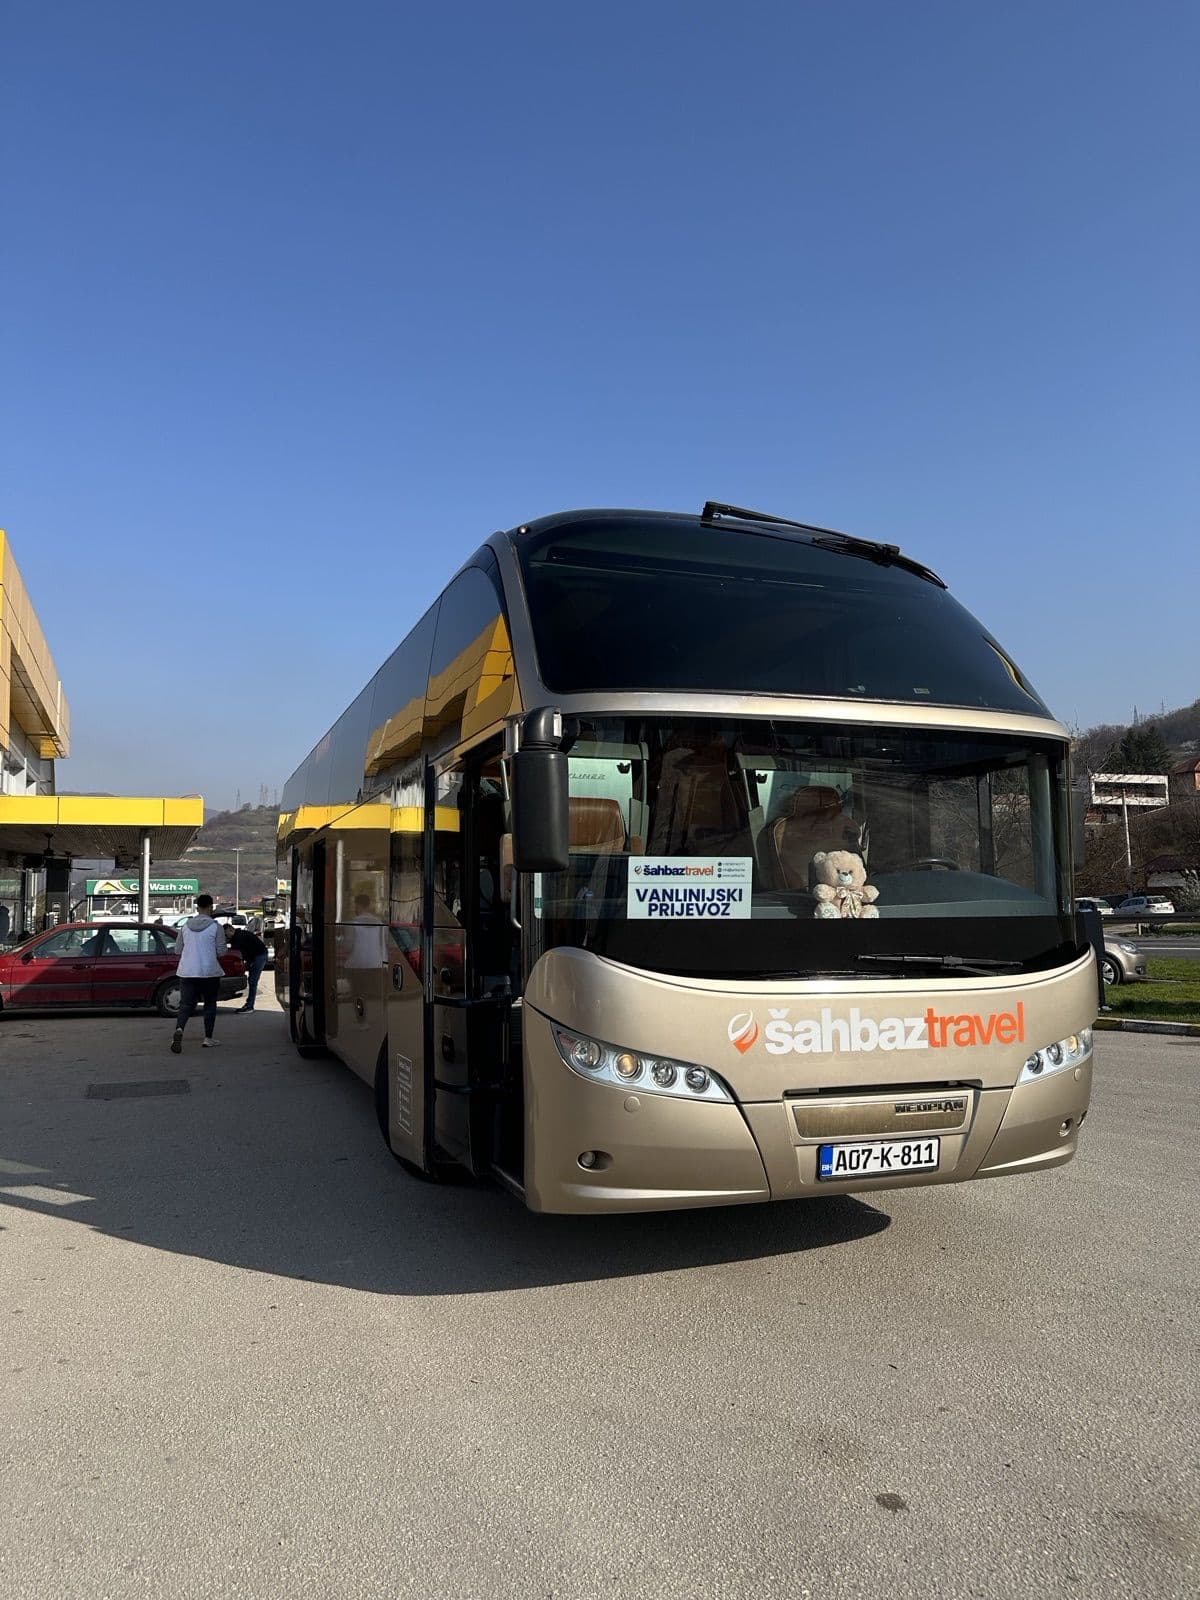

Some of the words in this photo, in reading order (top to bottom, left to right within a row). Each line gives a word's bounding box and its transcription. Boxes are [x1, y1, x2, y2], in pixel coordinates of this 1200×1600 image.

[643, 865, 714, 876] šahbaztravel
[150, 883, 176, 891] Wash
[635, 888, 743, 902] VANLINIJSKI
[648, 903, 731, 916] PRIJEVOZ
[765, 1001, 1025, 1055] šahbaztravel
[895, 1101, 964, 1114] NEOPLAN
[835, 1143, 934, 1171] A07-K-811
